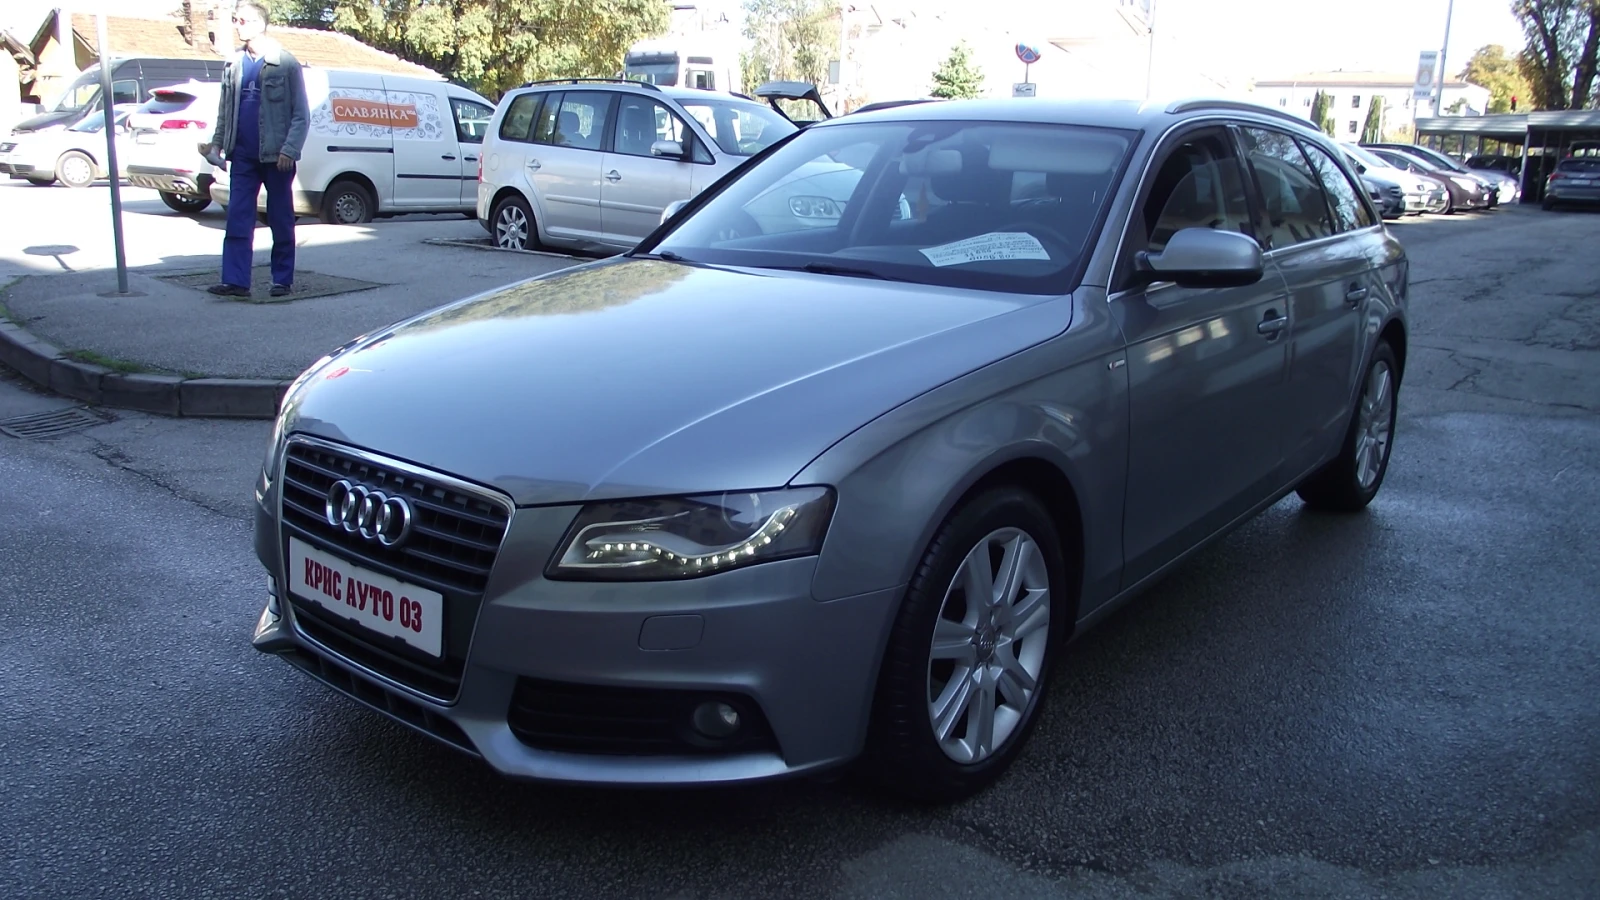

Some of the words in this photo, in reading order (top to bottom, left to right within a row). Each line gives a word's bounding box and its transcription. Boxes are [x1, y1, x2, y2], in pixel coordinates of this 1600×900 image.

[335, 105, 409, 120] СЛАВЯНКА
[304, 557, 342, 601] КРИС
[346, 577, 394, 622] АУТО
